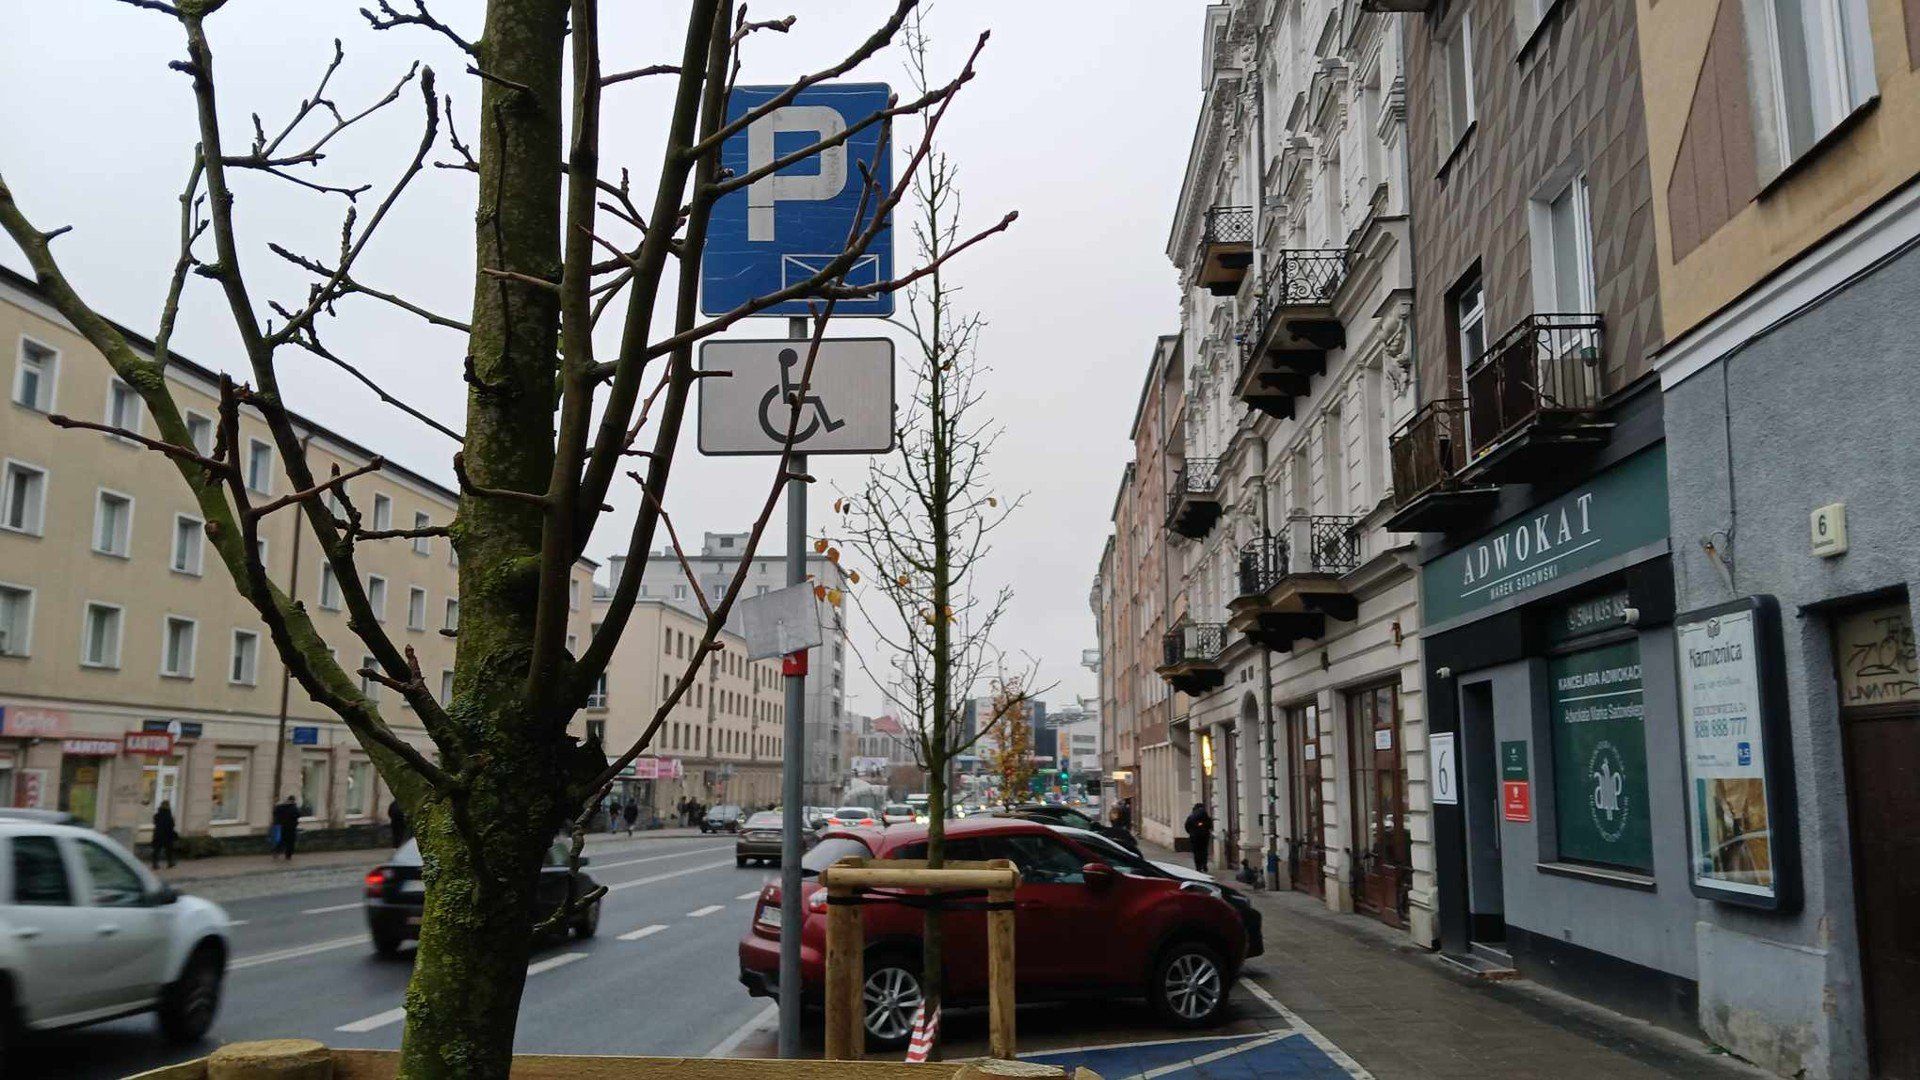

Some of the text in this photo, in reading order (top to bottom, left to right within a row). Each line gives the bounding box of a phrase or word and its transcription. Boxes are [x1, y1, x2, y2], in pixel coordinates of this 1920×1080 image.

[748, 106, 847, 241] P
[1463, 493, 1592, 585] ADWOKAT
[1818, 515, 1827, 536] 6
[1490, 564, 1558, 600] MAREK SADOWSKI
[1689, 642, 1743, 669] Kamienica
[1438, 750, 1449, 795] 6
